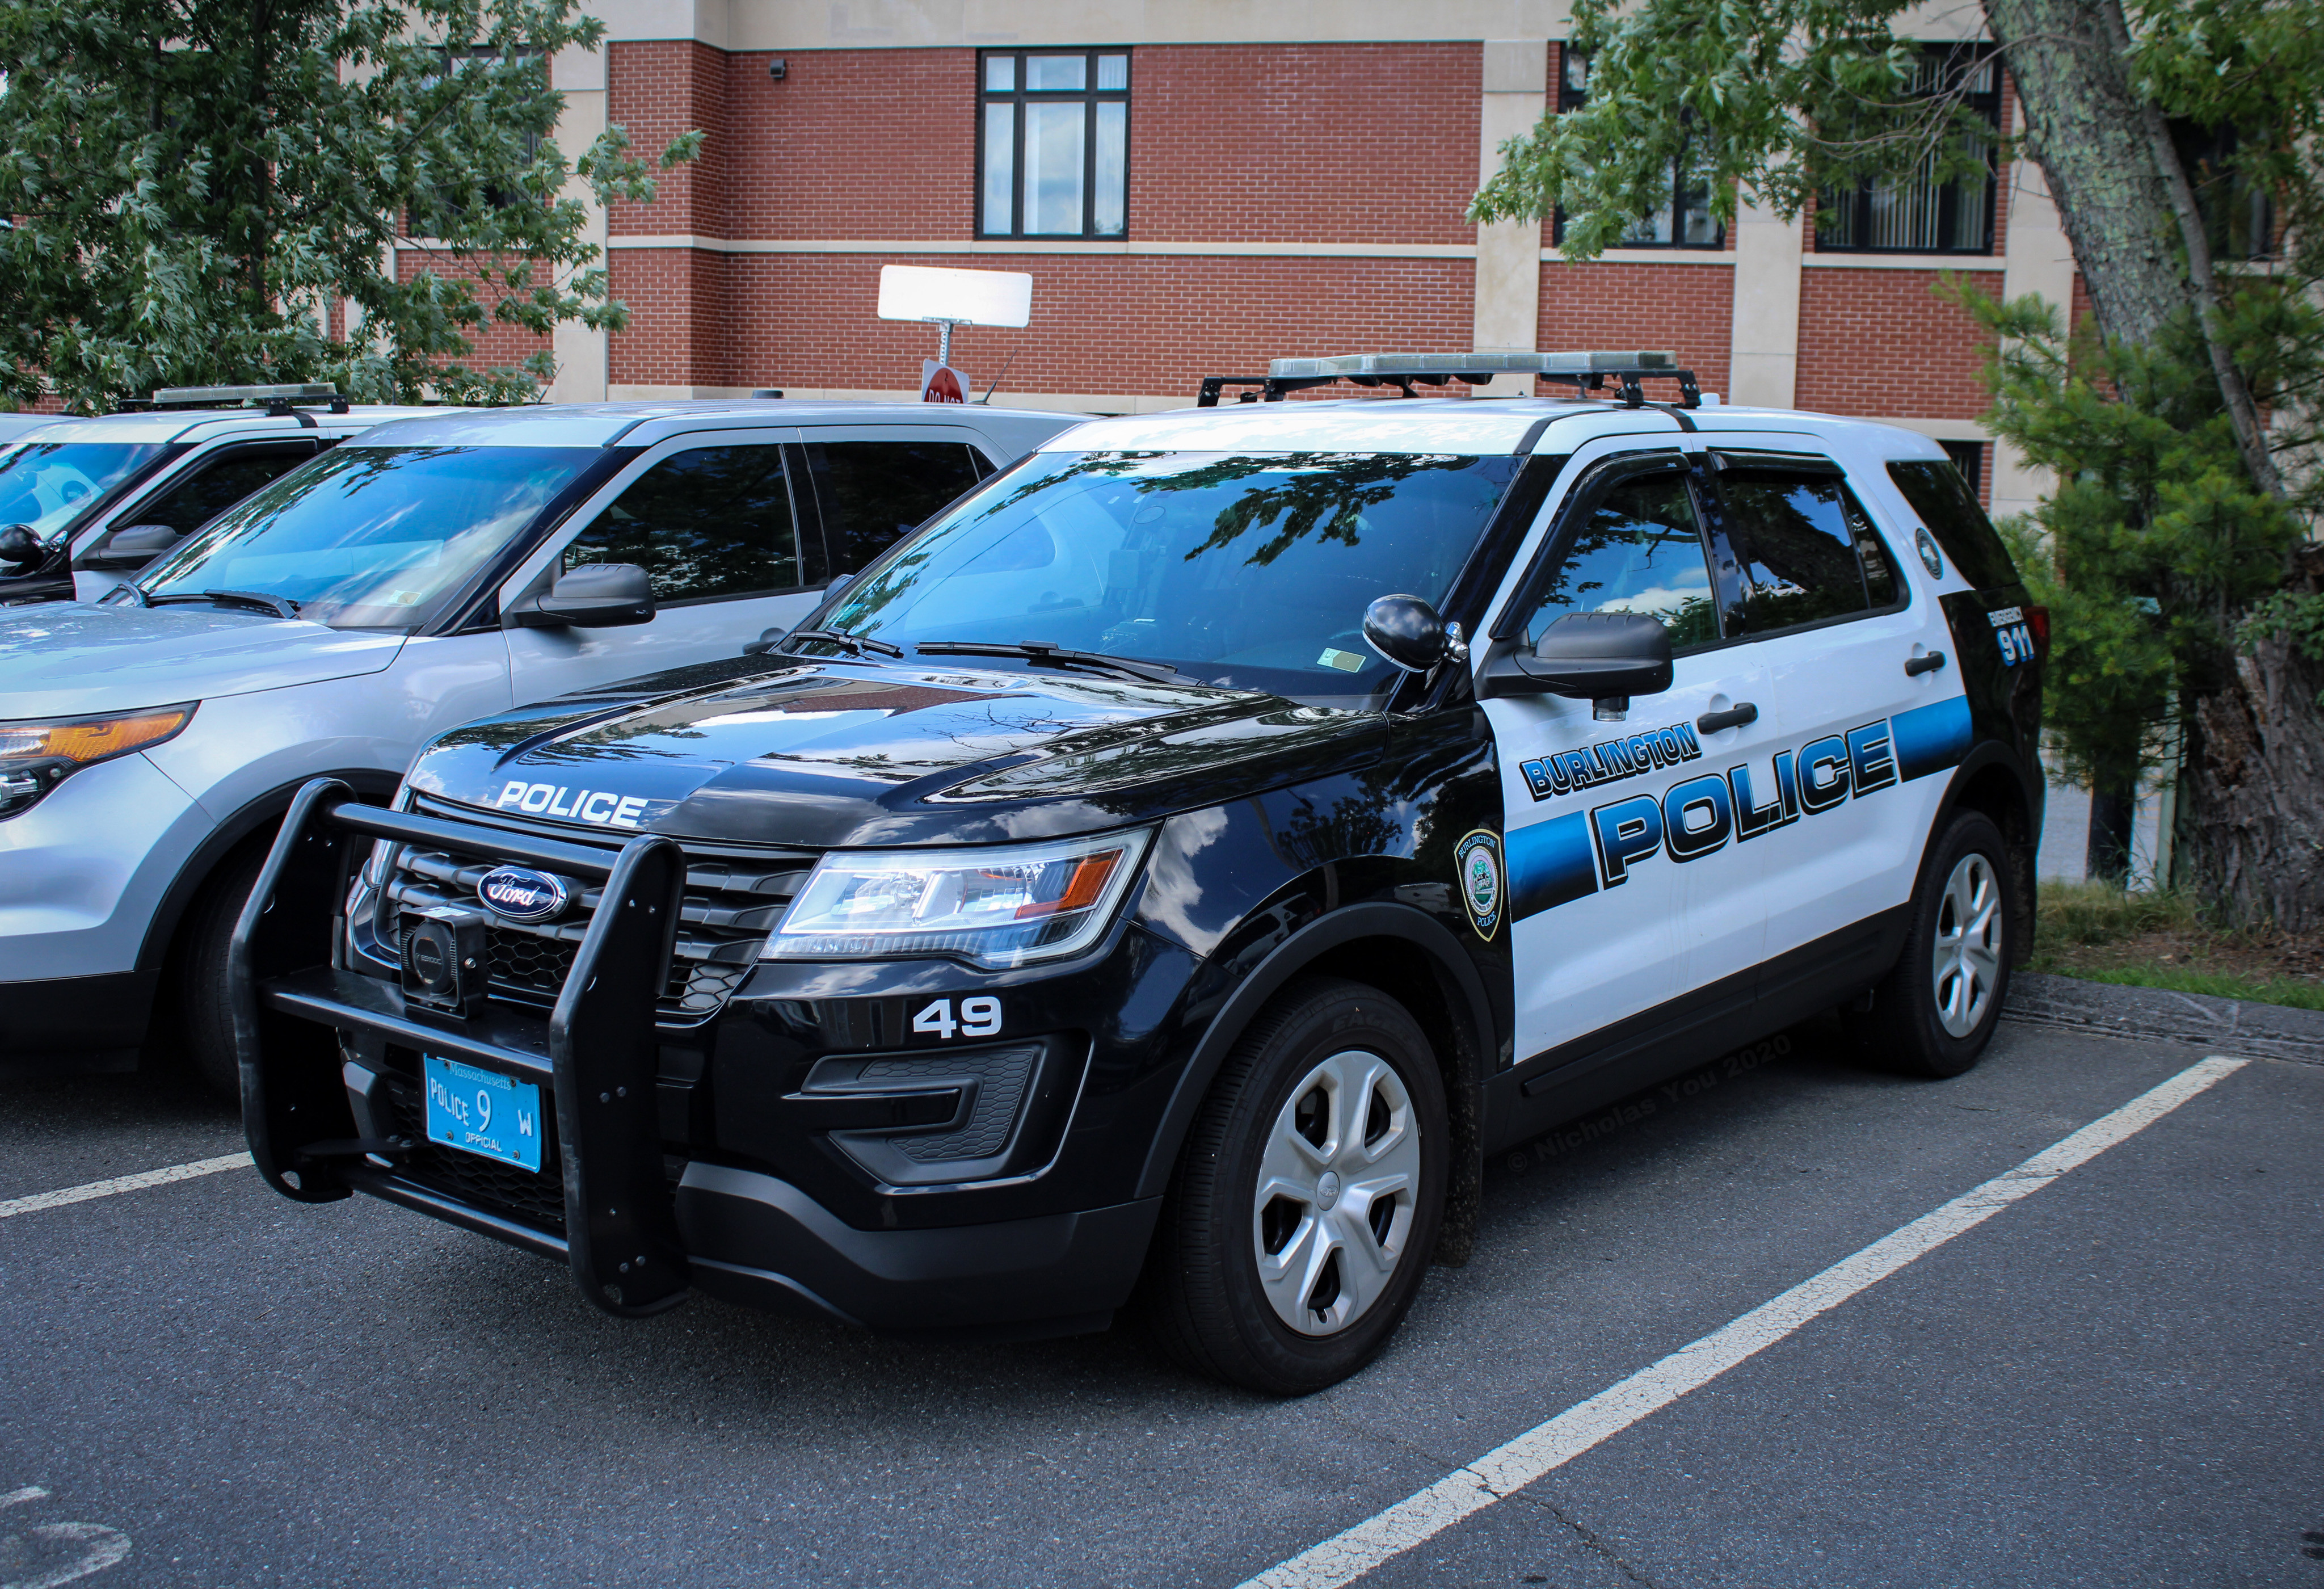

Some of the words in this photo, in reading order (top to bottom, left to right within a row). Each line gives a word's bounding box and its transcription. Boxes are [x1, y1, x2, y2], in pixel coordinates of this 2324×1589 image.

[1997, 623, 2035, 666] 911
[1519, 721, 1703, 802] BURLINGTON
[495, 781, 649, 828] POLICE
[1589, 718, 1898, 890] POLICE
[1458, 835, 1496, 859] BURLINGTON
[489, 872, 541, 907] Ford
[1477, 911, 1497, 927] POLICE
[913, 996, 1002, 1039] 49
[449, 1062, 512, 1090] Massachusetts
[430, 1077, 470, 1126] POLICE
[477, 1090, 491, 1132] 9
[517, 1109, 533, 1137] W
[465, 1132, 503, 1153] OFFICIAL
